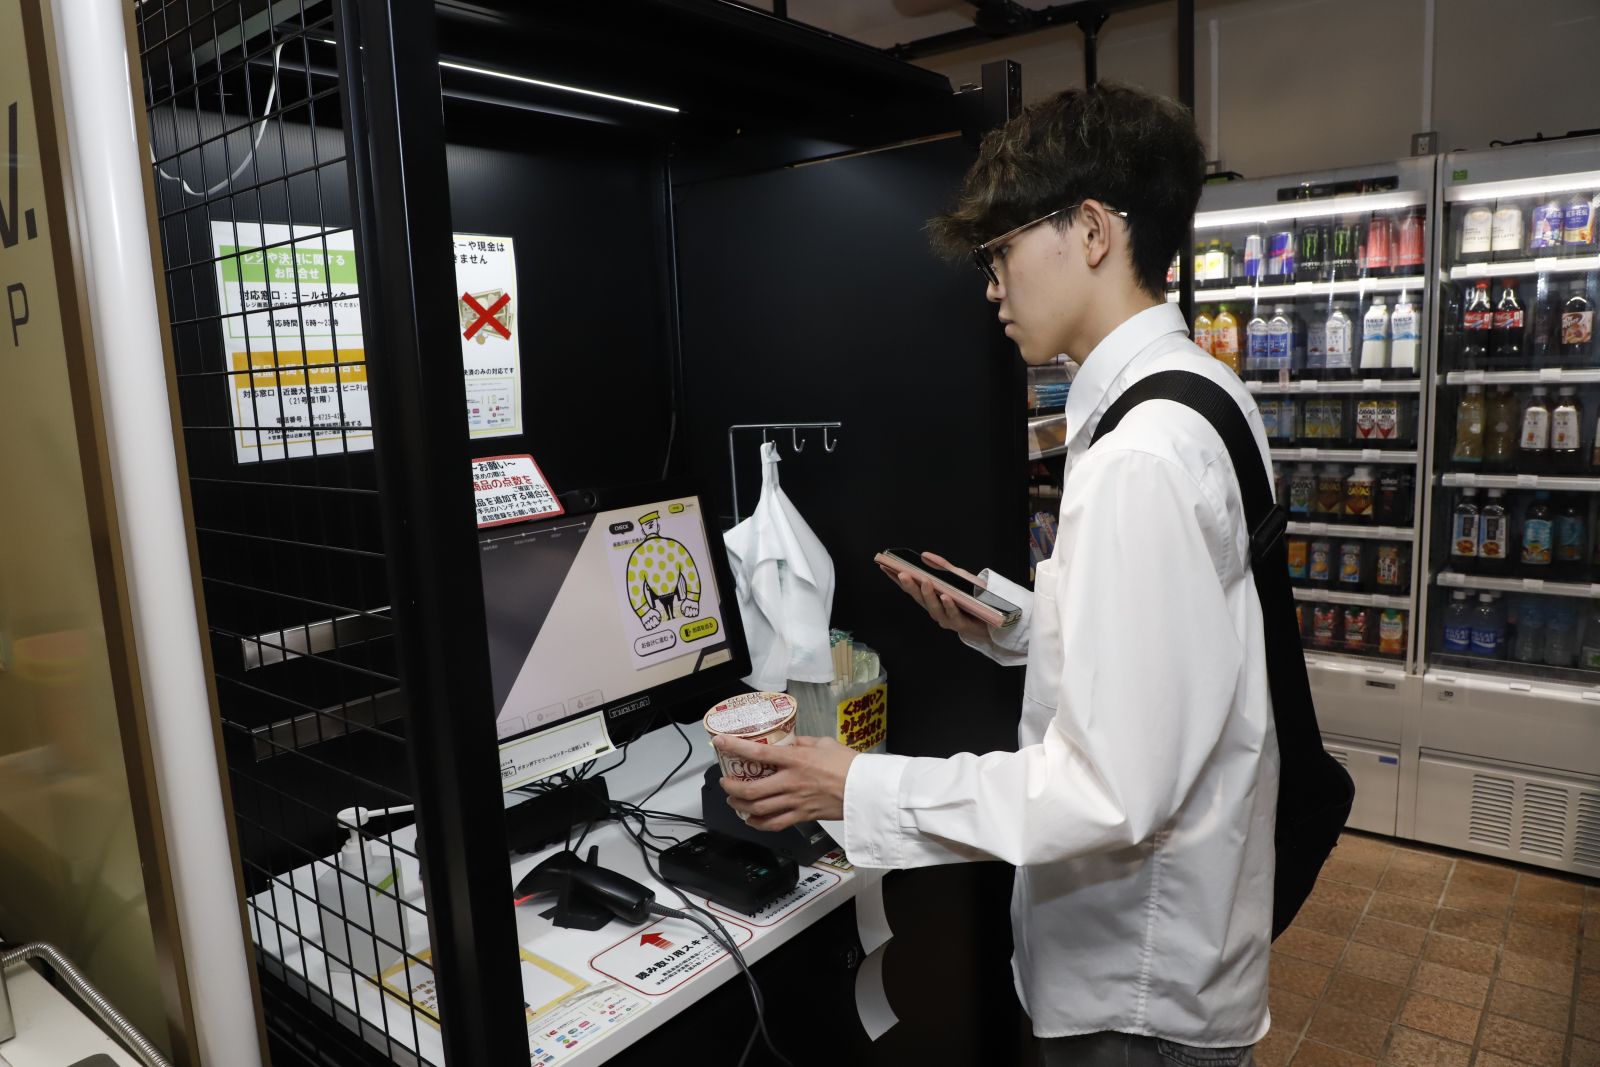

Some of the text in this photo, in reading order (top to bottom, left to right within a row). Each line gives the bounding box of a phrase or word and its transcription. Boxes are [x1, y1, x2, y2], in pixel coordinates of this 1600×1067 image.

[473, 470, 506, 481] 求めの際は
[475, 490, 550, 508] 品を追加する場合は
[635, 927, 721, 980] 読み取り用スキャ
